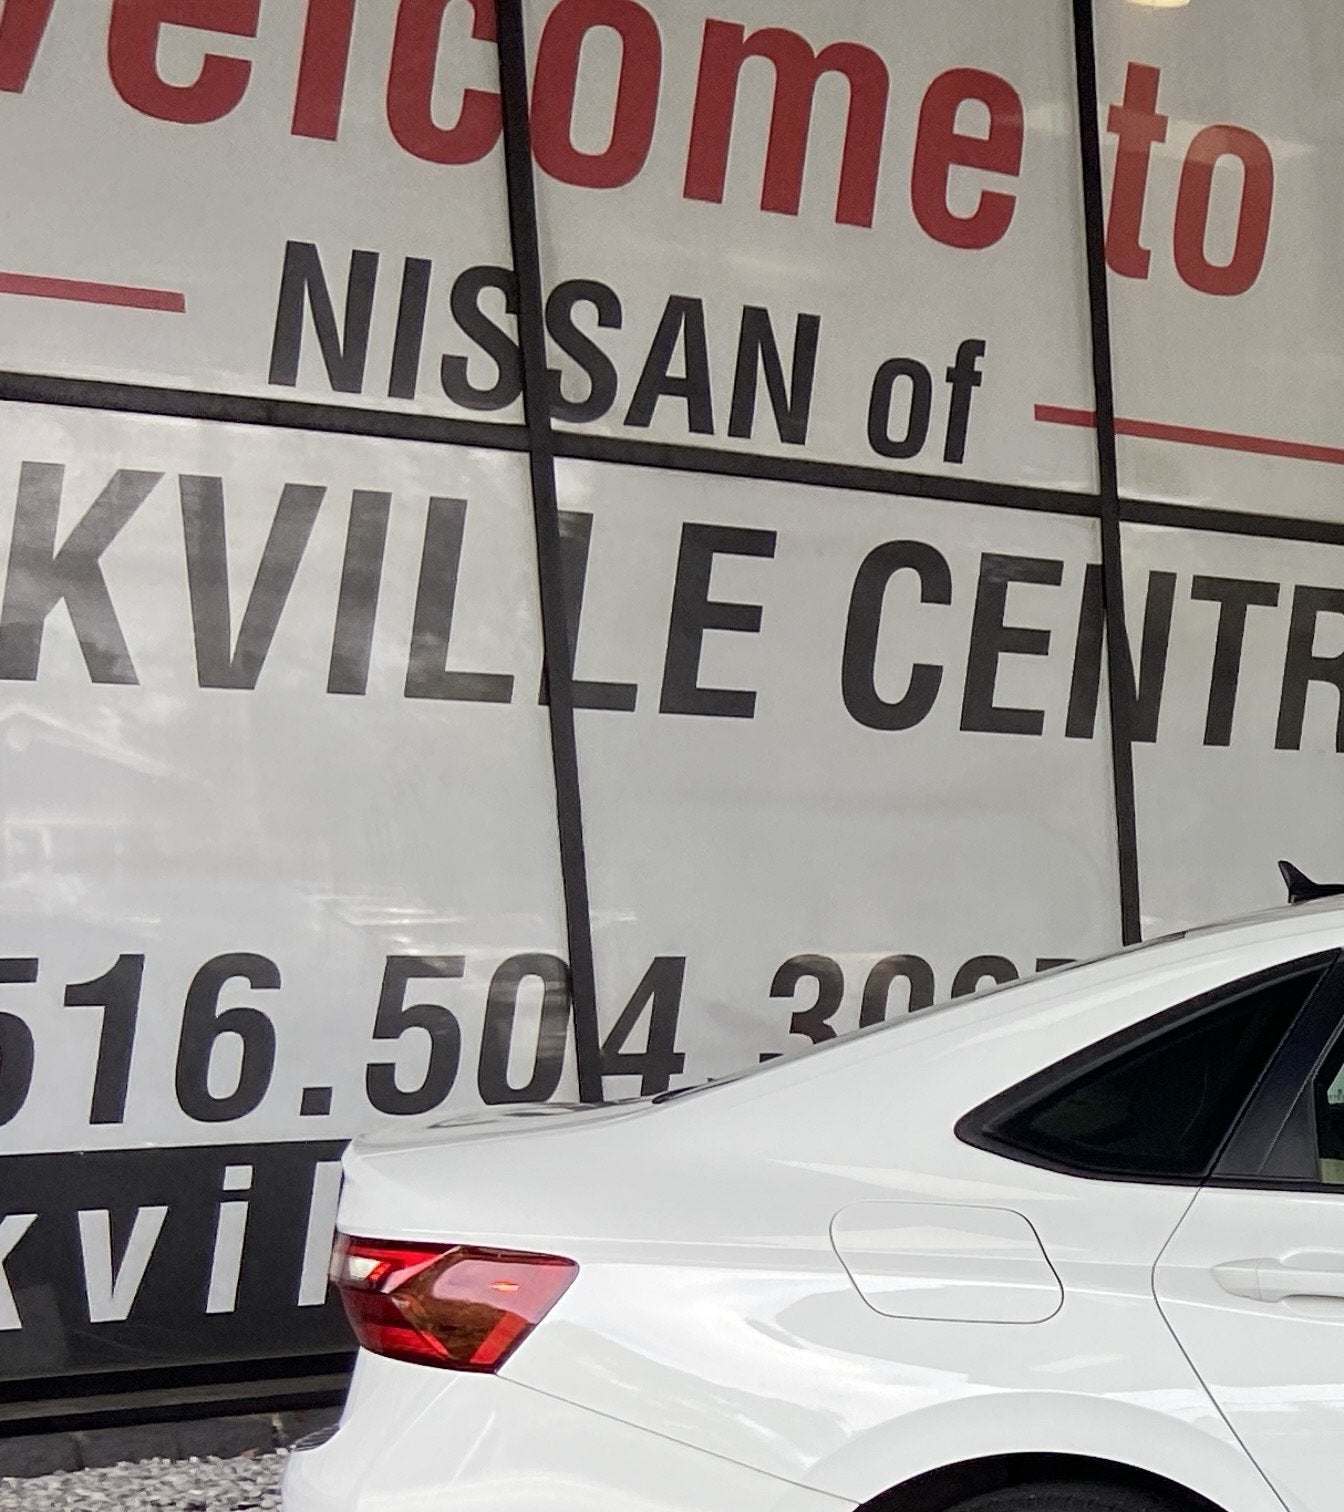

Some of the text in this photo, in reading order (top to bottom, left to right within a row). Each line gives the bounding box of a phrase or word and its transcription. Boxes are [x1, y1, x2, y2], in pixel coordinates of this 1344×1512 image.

[0, 0, 1275, 297] elcome to
[268, 240, 987, 465] NISSAN of
